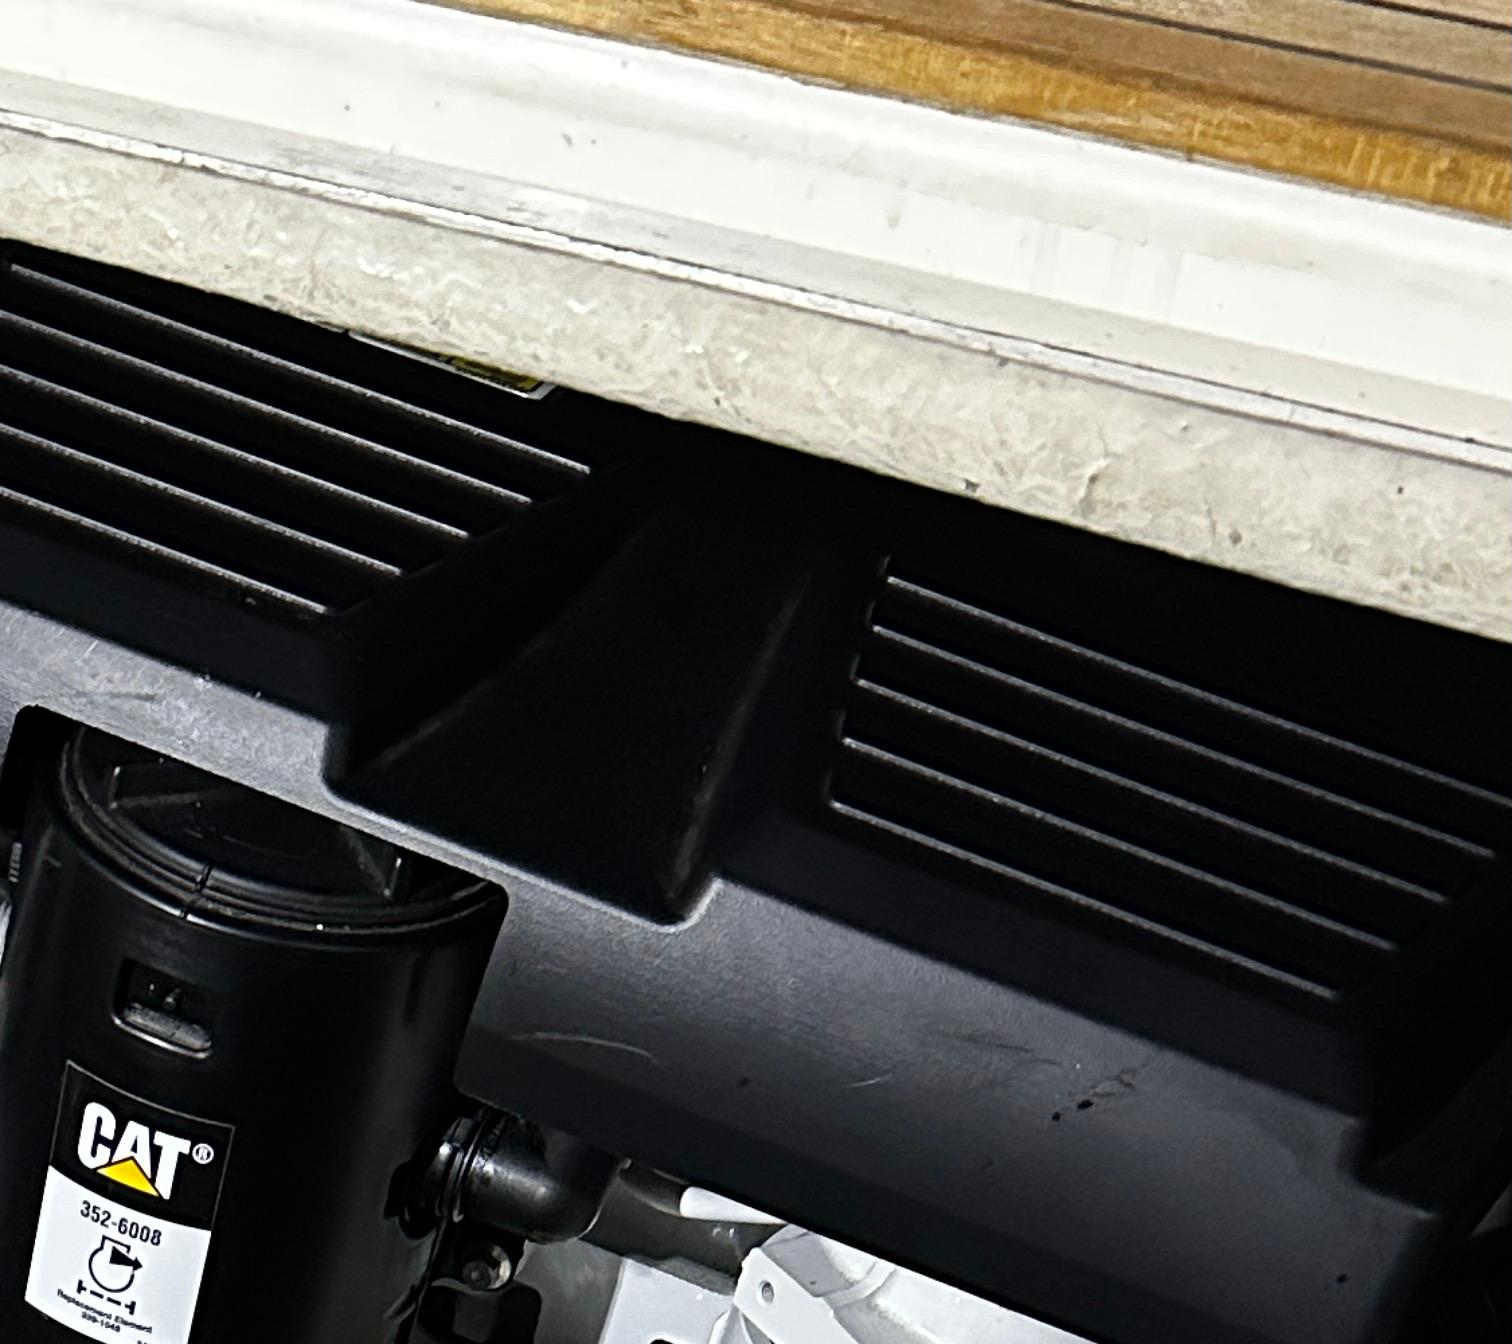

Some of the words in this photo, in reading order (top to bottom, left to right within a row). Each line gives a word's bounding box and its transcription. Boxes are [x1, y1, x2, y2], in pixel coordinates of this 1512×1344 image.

[79, 1199, 163, 1248] 352-6008
[56, 1287, 113, 1321] Replacement
[114, 1314, 154, 1335] Element
